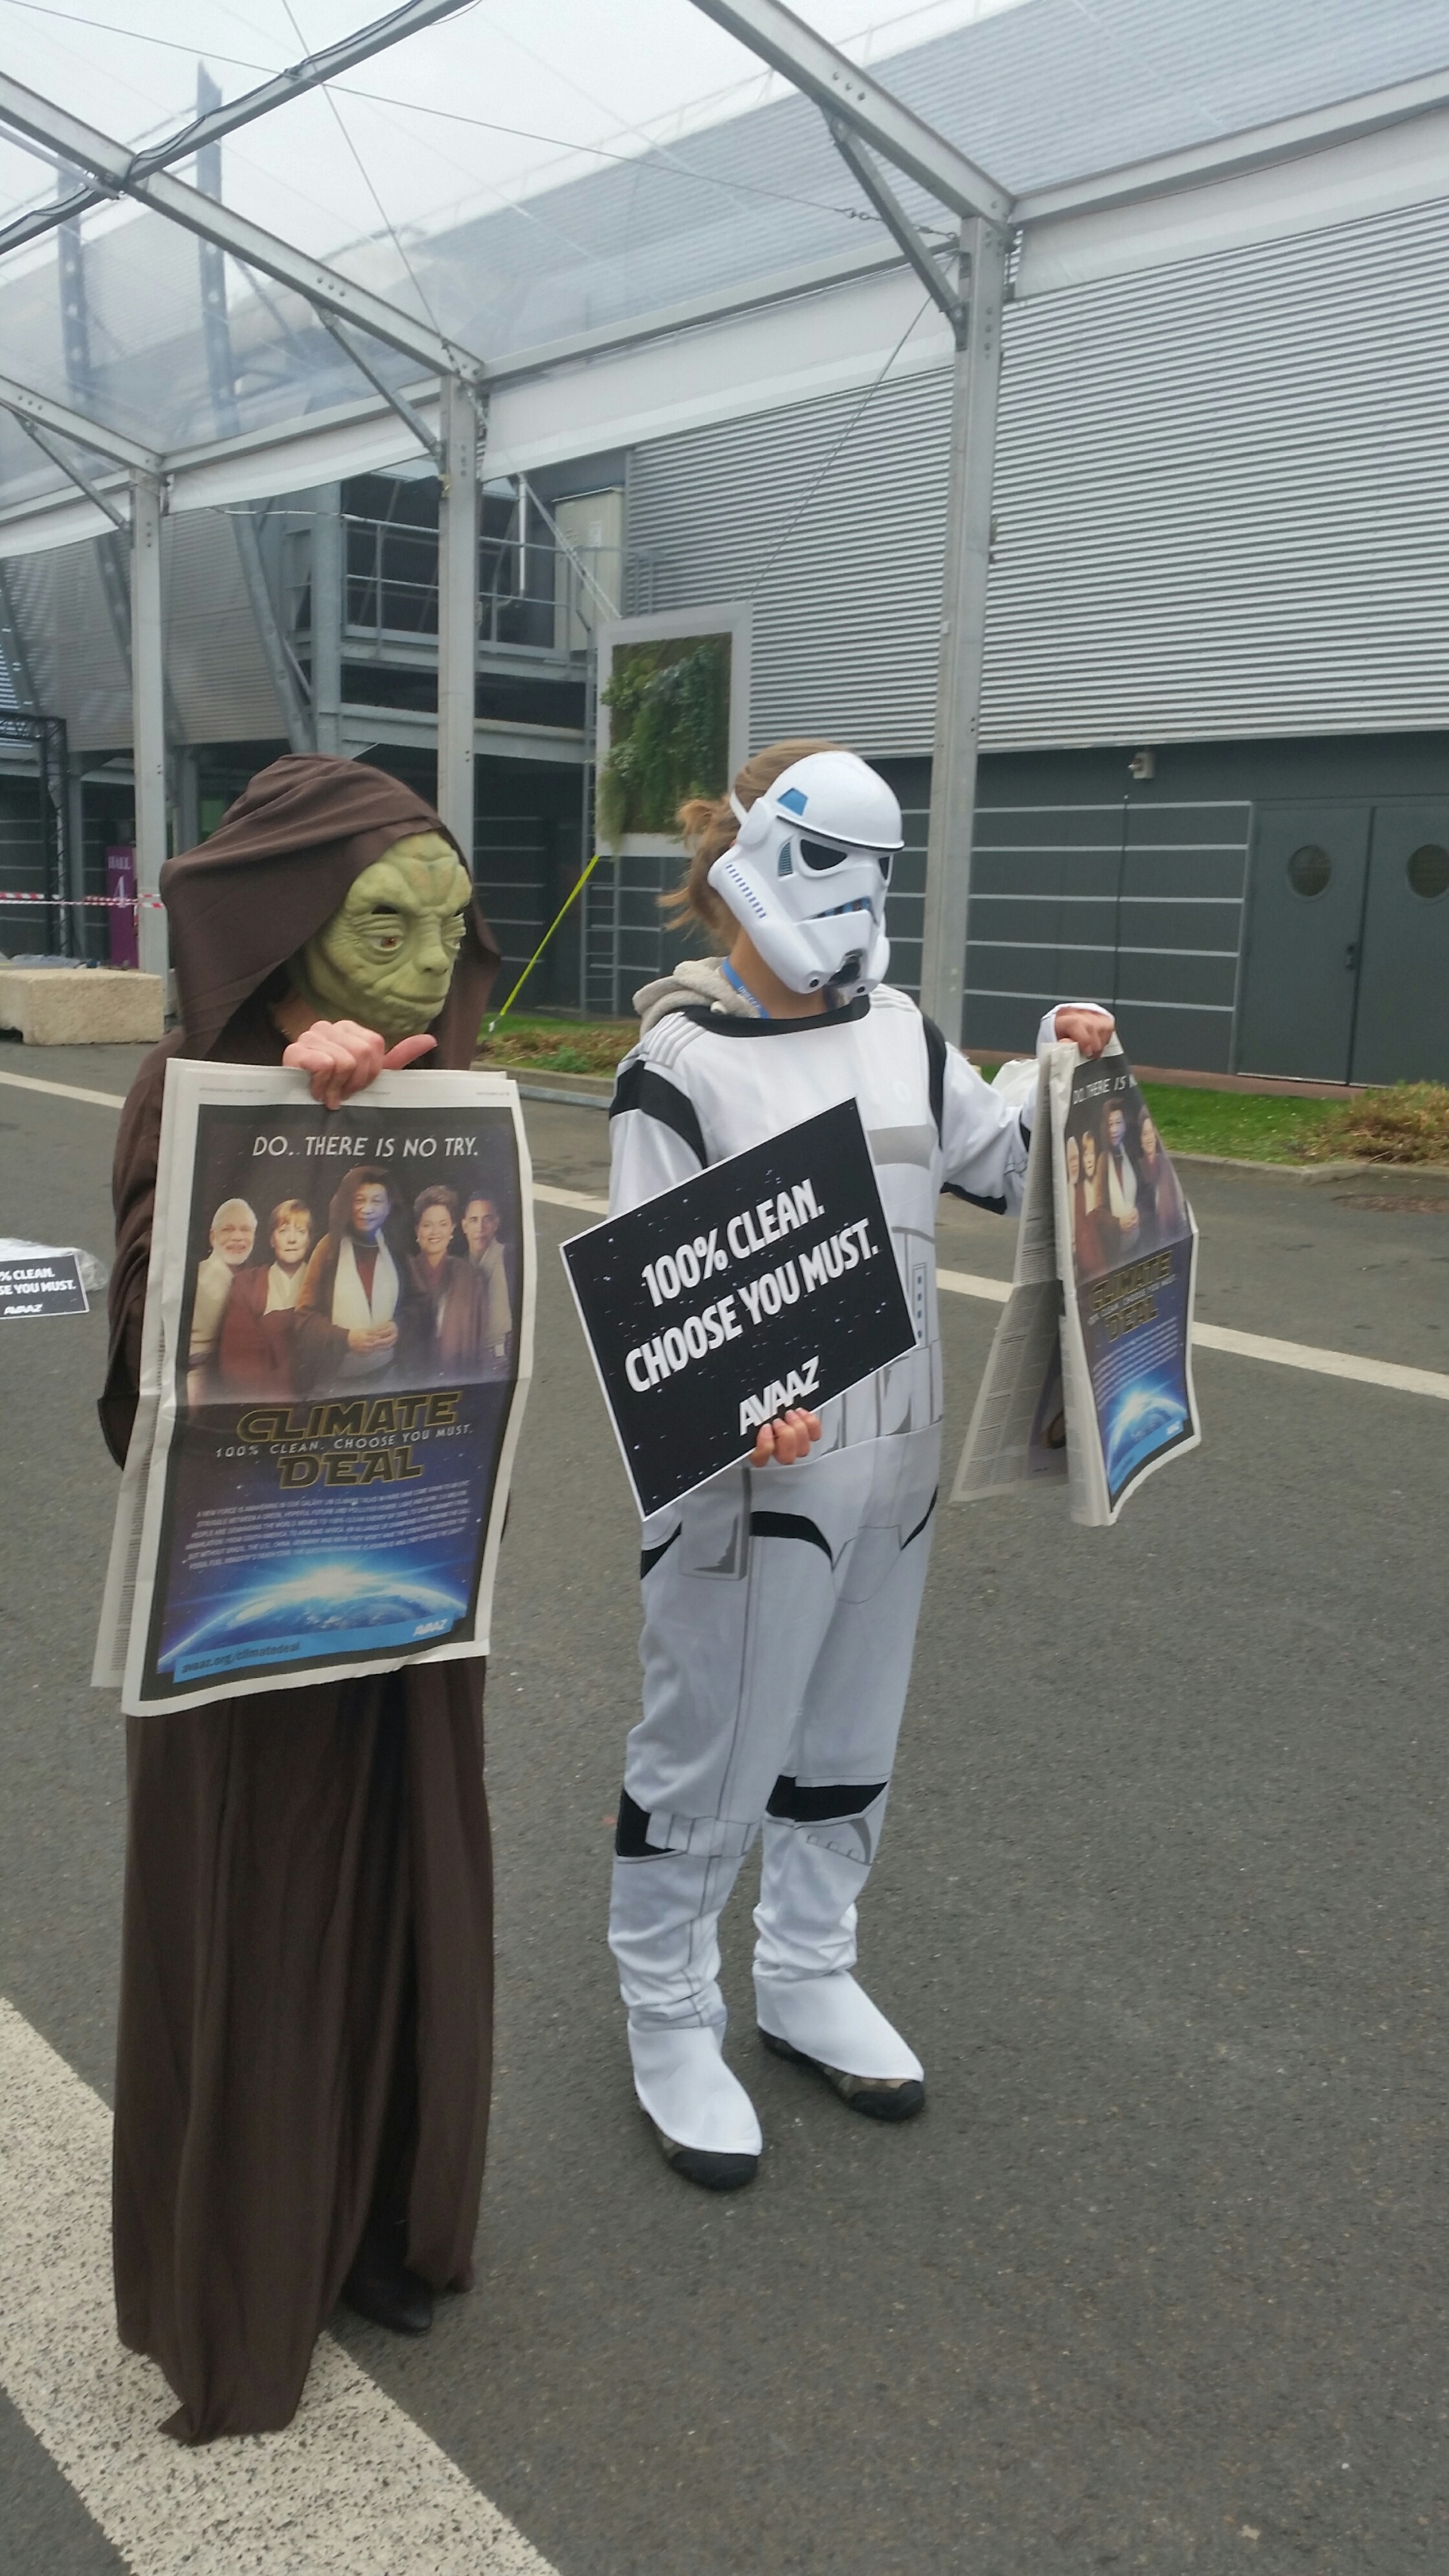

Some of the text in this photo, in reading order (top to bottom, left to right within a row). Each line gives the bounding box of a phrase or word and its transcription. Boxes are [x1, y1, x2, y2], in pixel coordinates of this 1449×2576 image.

[113, 876, 128, 908] 4
[1114, 1075, 1127, 1091] IS
[305, 1135, 368, 1157] THERE
[375, 1137, 395, 1157] IS
[402, 1137, 438, 1158] NO
[444, 1136, 479, 1157] TRY.
[641, 1177, 826, 1307] 100% CLEAN.
[13, 1267, 56, 1281] CLEAN.
[14, 1282, 41, 1294] YOU
[40, 1279, 77, 1292] MUST.
[1092, 1249, 1174, 1313] CLIMATE
[625, 1217, 879, 1393] CHOOSE YOU MUST.
[1104, 1294, 1160, 1343] DEAL
[739, 1354, 820, 1436] AVAAZ
[236, 1390, 464, 1443] CLIMATE
[216, 1423, 474, 1457] 100% CLEAN. CHOOSE YOU MUST.
[277, 1445, 424, 1490] DEAL
[180, 1641, 301, 1674] avaaz.org/climatedeal
